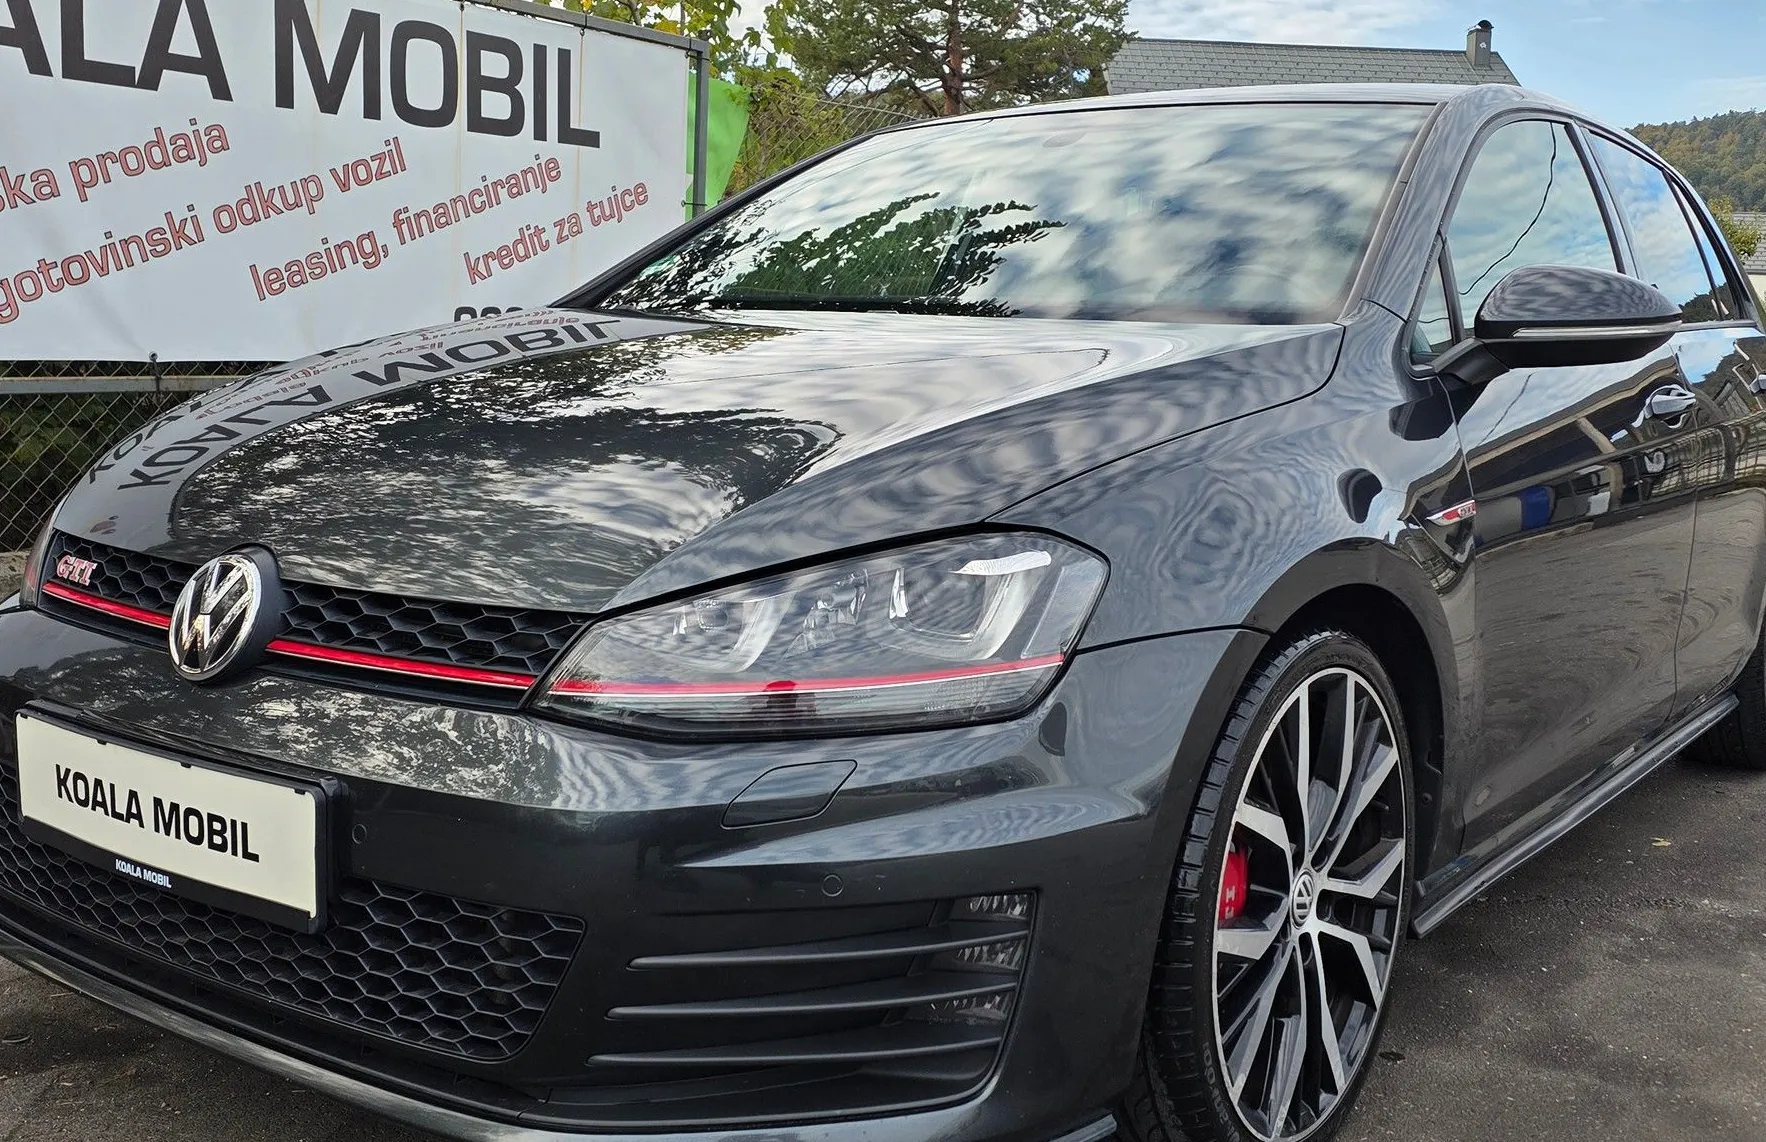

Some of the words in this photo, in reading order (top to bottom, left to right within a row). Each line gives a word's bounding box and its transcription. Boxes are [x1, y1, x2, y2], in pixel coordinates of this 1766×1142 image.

[274, 0, 600, 148] MOBIL
[0, 166, 61, 212] ka
[69, 118, 230, 202] prodaja
[0, 204, 205, 324] gotovinski
[213, 181, 324, 234] odkup
[329, 136, 407, 193] vozil
[249, 229, 389, 301] leasing,
[393, 154, 562, 245] financiranje
[463, 224, 550, 285] kredit
[553, 212, 583, 245] za
[586, 181, 649, 227] tujce
[56, 554, 98, 587] GTI
[55, 763, 145, 829] KOALA
[153, 796, 260, 863] MOBIL
[115, 858, 142, 879] KOALA
[143, 868, 172, 889] MOBIL
